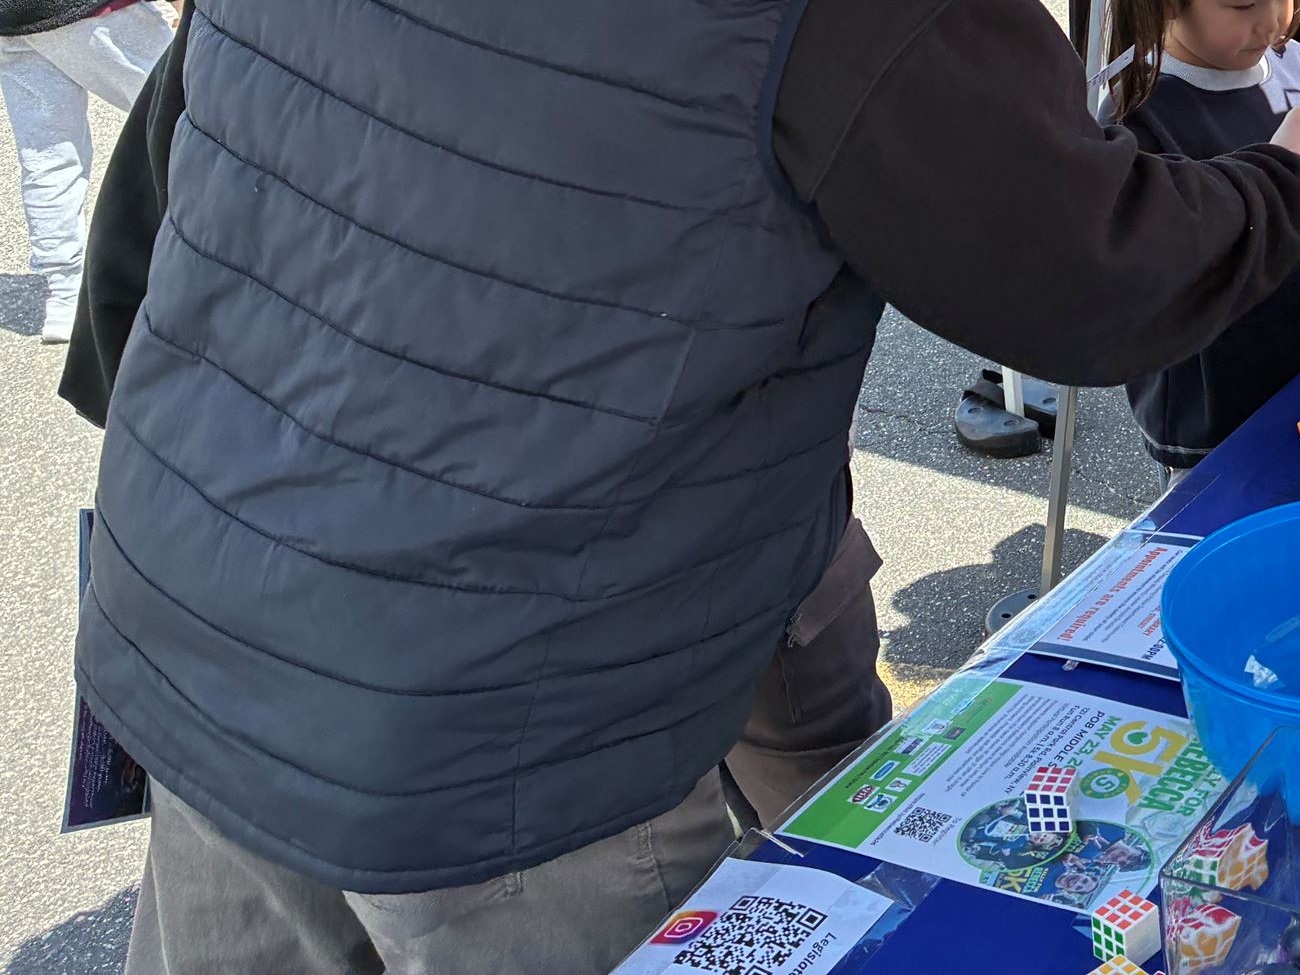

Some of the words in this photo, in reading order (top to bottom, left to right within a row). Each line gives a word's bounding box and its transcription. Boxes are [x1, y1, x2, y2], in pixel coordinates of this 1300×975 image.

[1109, 546, 1168, 593] Appointments
[1095, 593, 1114, 606] are
[1056, 606, 1100, 641] required!
[1057, 714, 1070, 726] Run
[1068, 704, 1081, 715] Fun
[1084, 710, 1105, 729] POB
[1061, 714, 1082, 736] Central
[1093, 715, 1122, 740] MAY
[1049, 733, 1062, 748] Park
[1053, 729, 1088, 762] MIDDLE
[1073, 738, 1100, 757] 23,
[1011, 756, 1042, 786] Plainview,
[1092, 720, 1190, 806] 5K
[1004, 784, 1016, 794] NY
[1177, 788, 1209, 817] FOR
